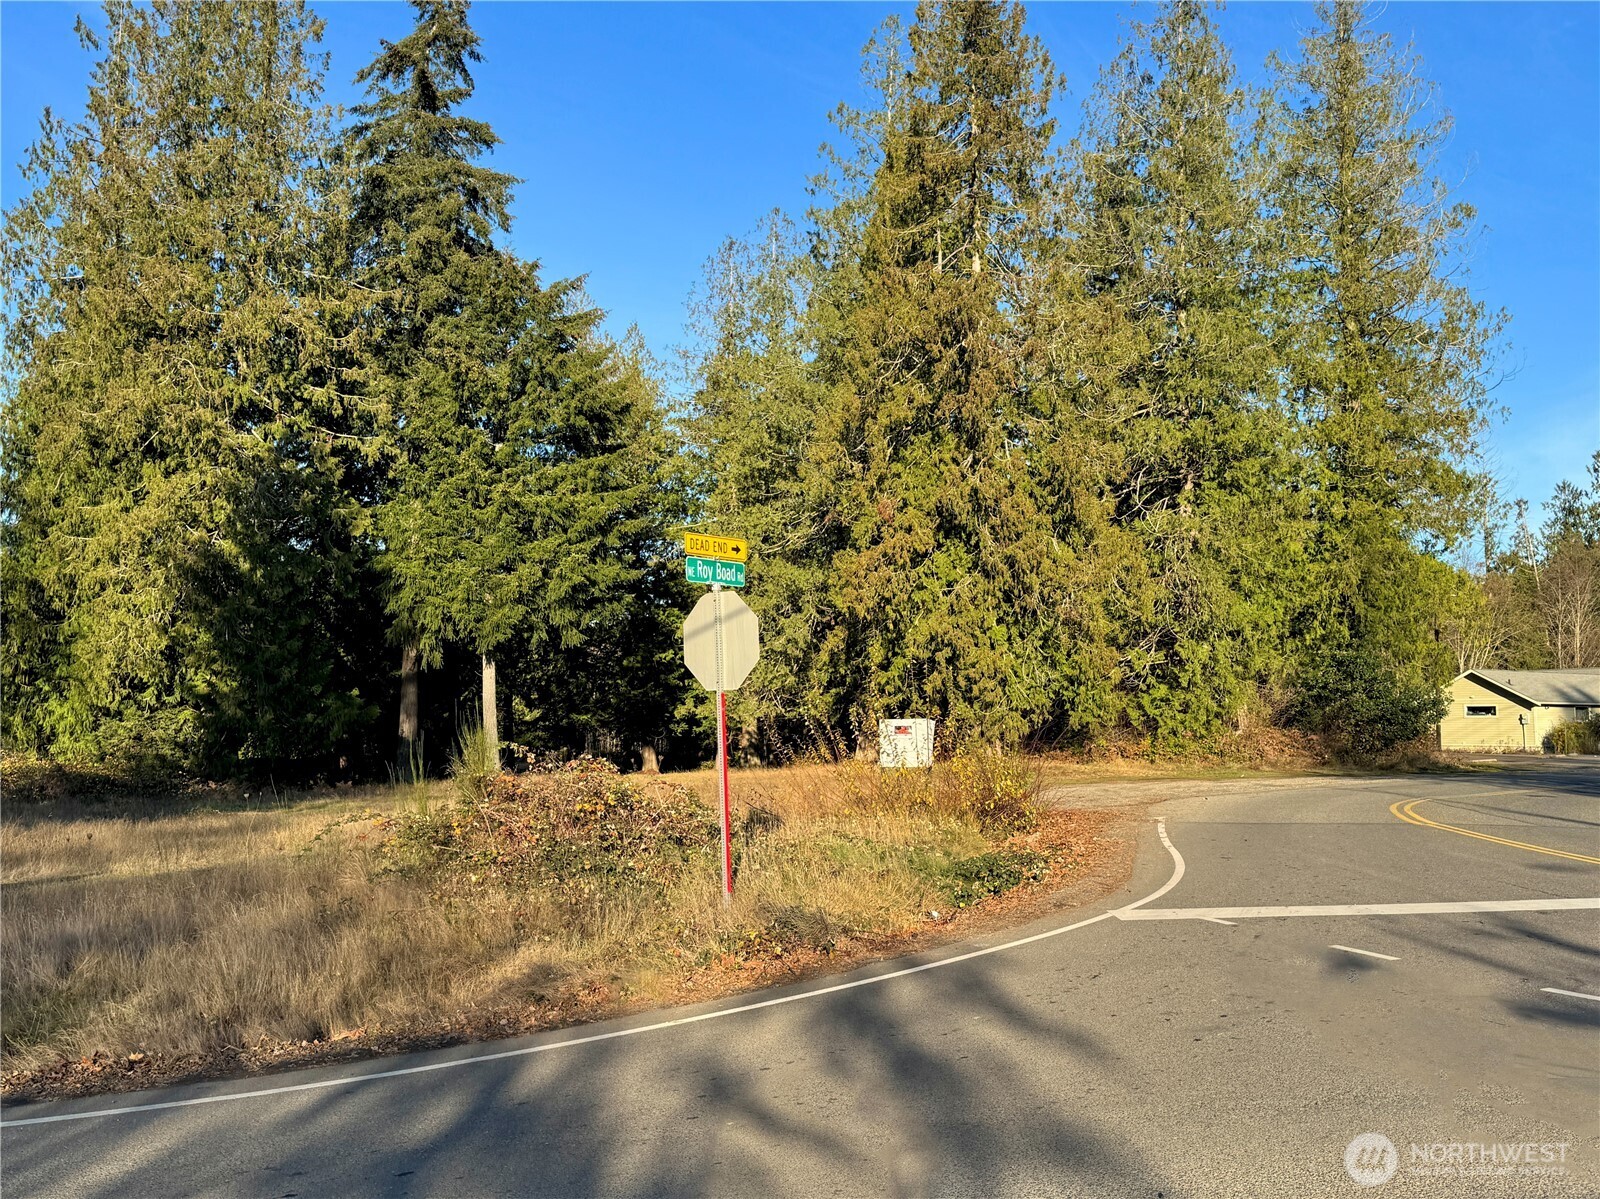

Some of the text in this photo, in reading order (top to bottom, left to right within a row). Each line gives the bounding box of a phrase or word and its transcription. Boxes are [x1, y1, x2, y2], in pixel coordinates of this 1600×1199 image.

[690, 538, 727, 553] DEAD END
[697, 561, 713, 581] Roy
[717, 562, 735, 581] Boad
